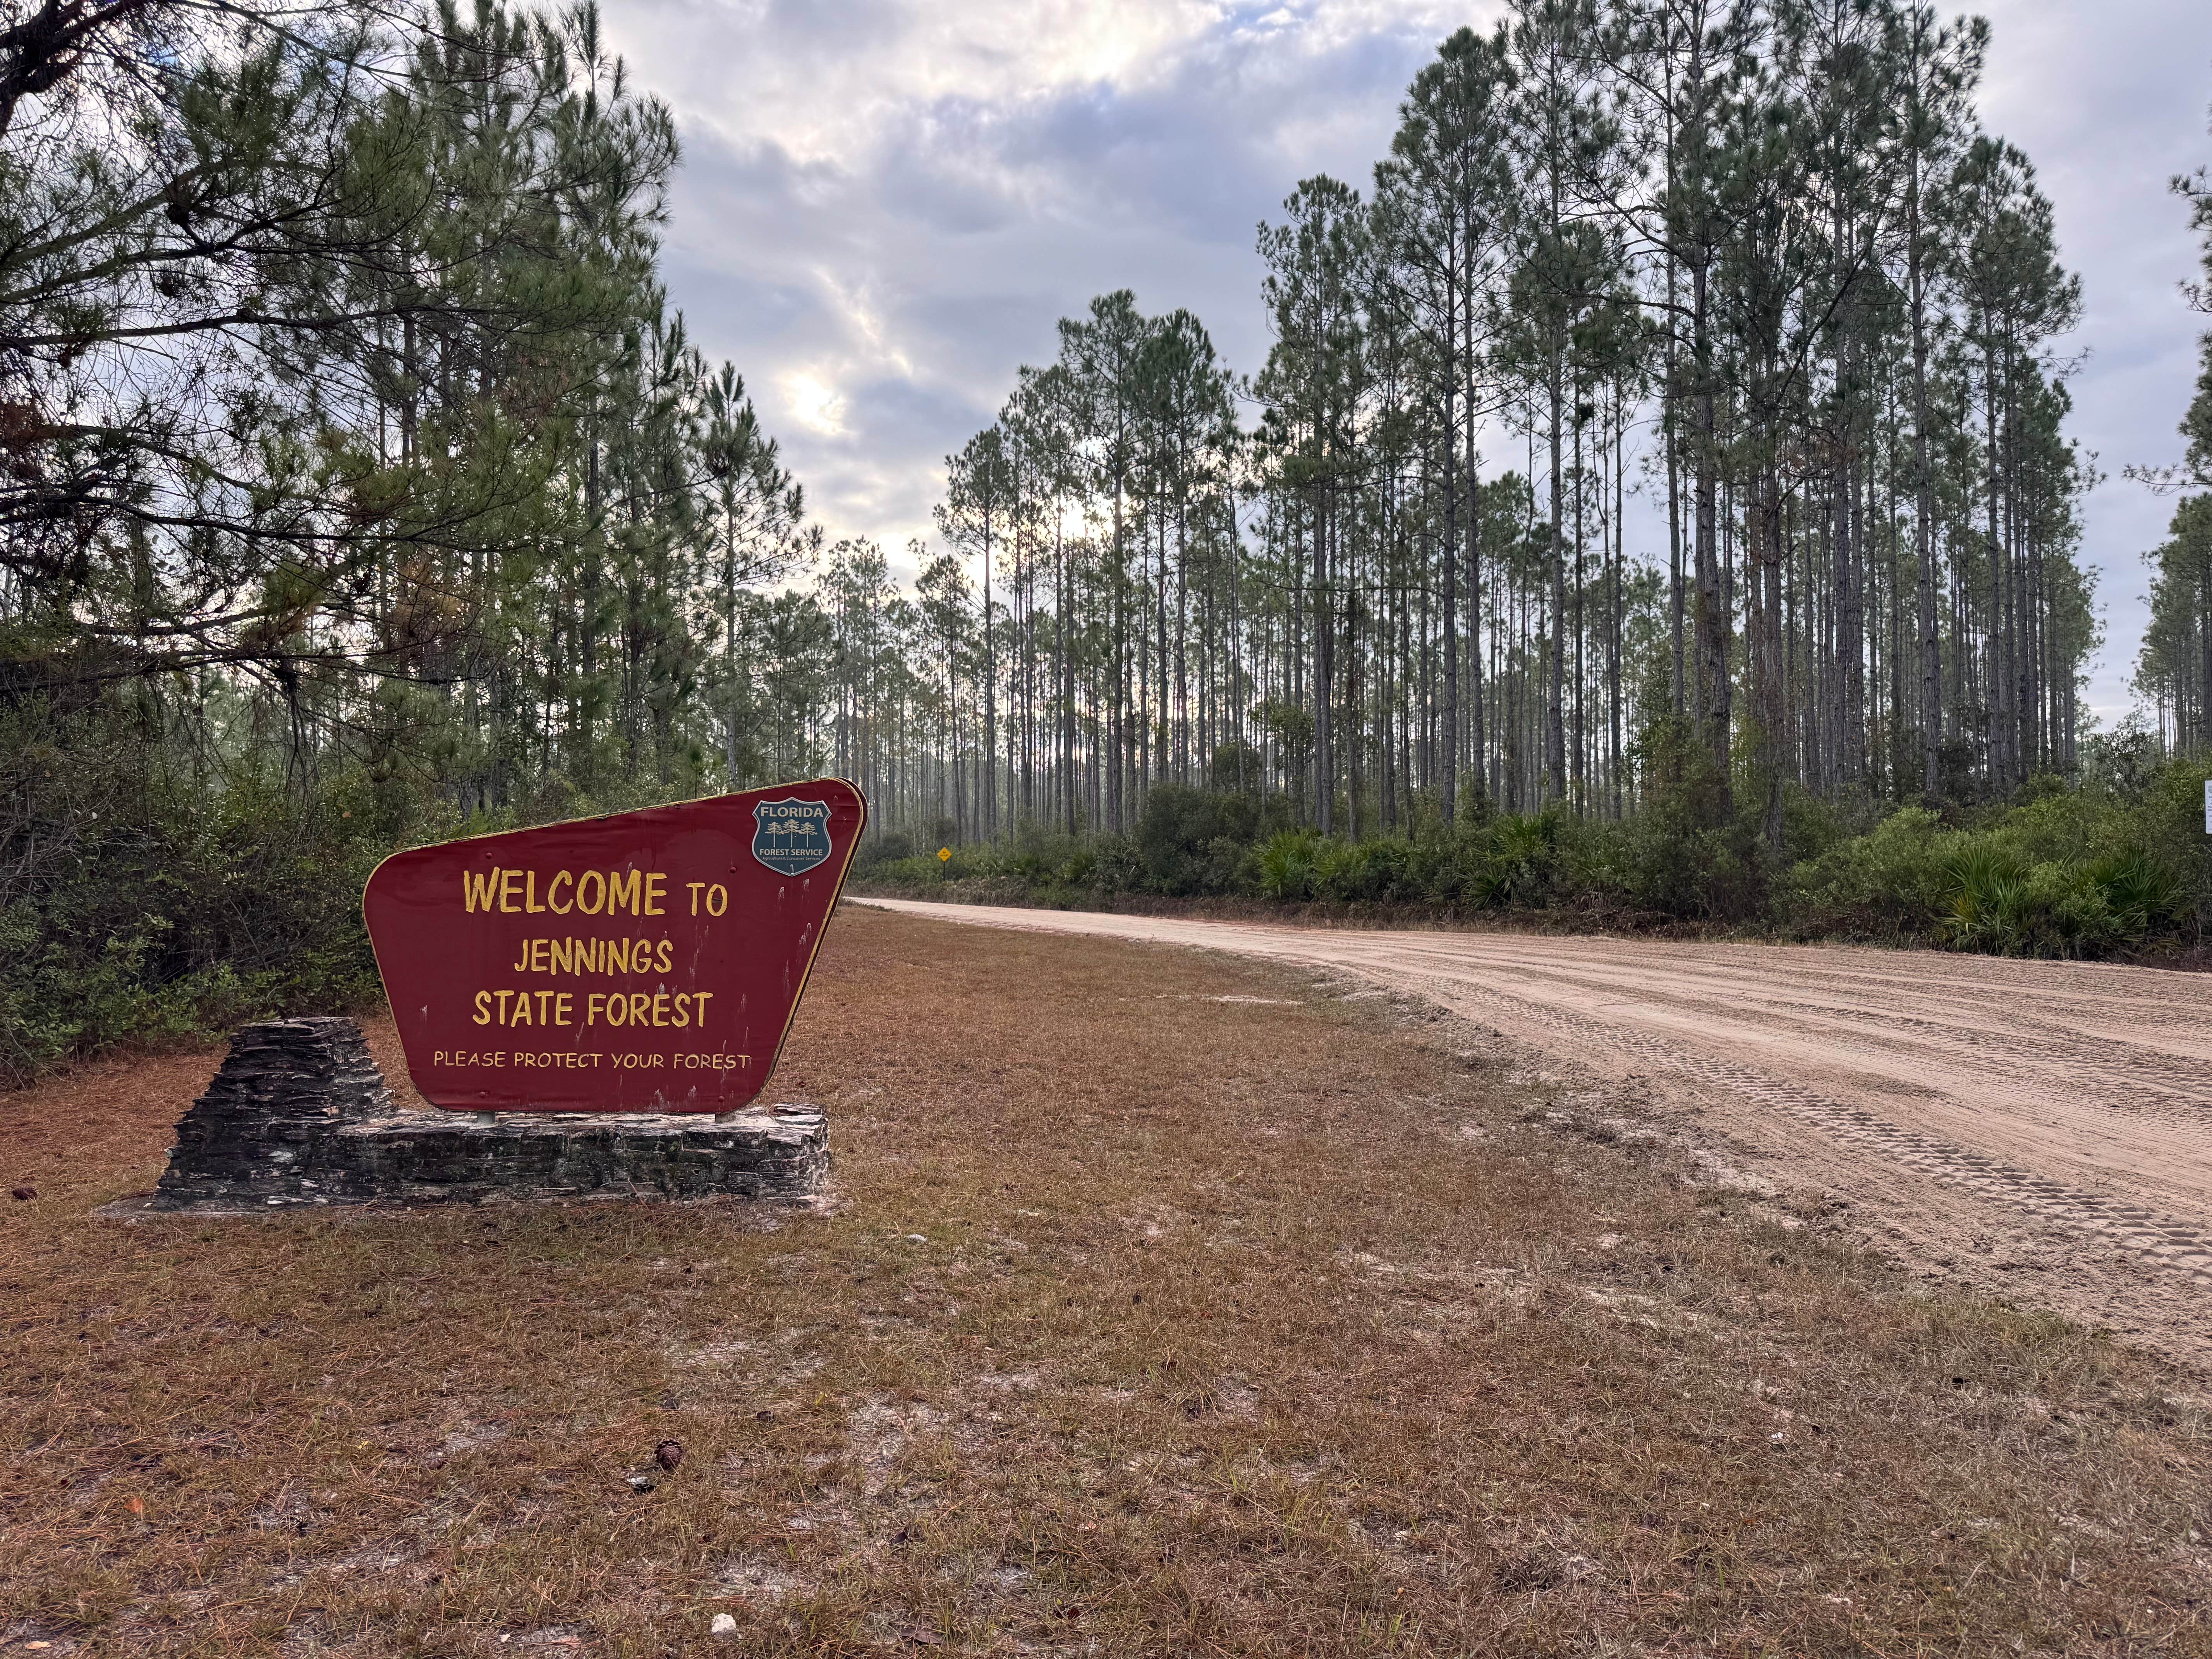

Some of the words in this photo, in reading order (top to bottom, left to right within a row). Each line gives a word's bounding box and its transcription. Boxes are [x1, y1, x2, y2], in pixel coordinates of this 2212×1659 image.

[761, 807, 823, 817] FLORIDA
[463, 866, 667, 916] WELCOME
[685, 882, 728, 917] TO
[514, 937, 673, 976] JENNINGS
[472, 989, 574, 1028] STATE
[587, 991, 714, 1028] FOREST
[434, 1051, 506, 1068] PLEASE
[514, 1052, 603, 1068] PROTECT
[611, 1053, 664, 1069] YOUR
[674, 1054, 750, 1070] FOREST
